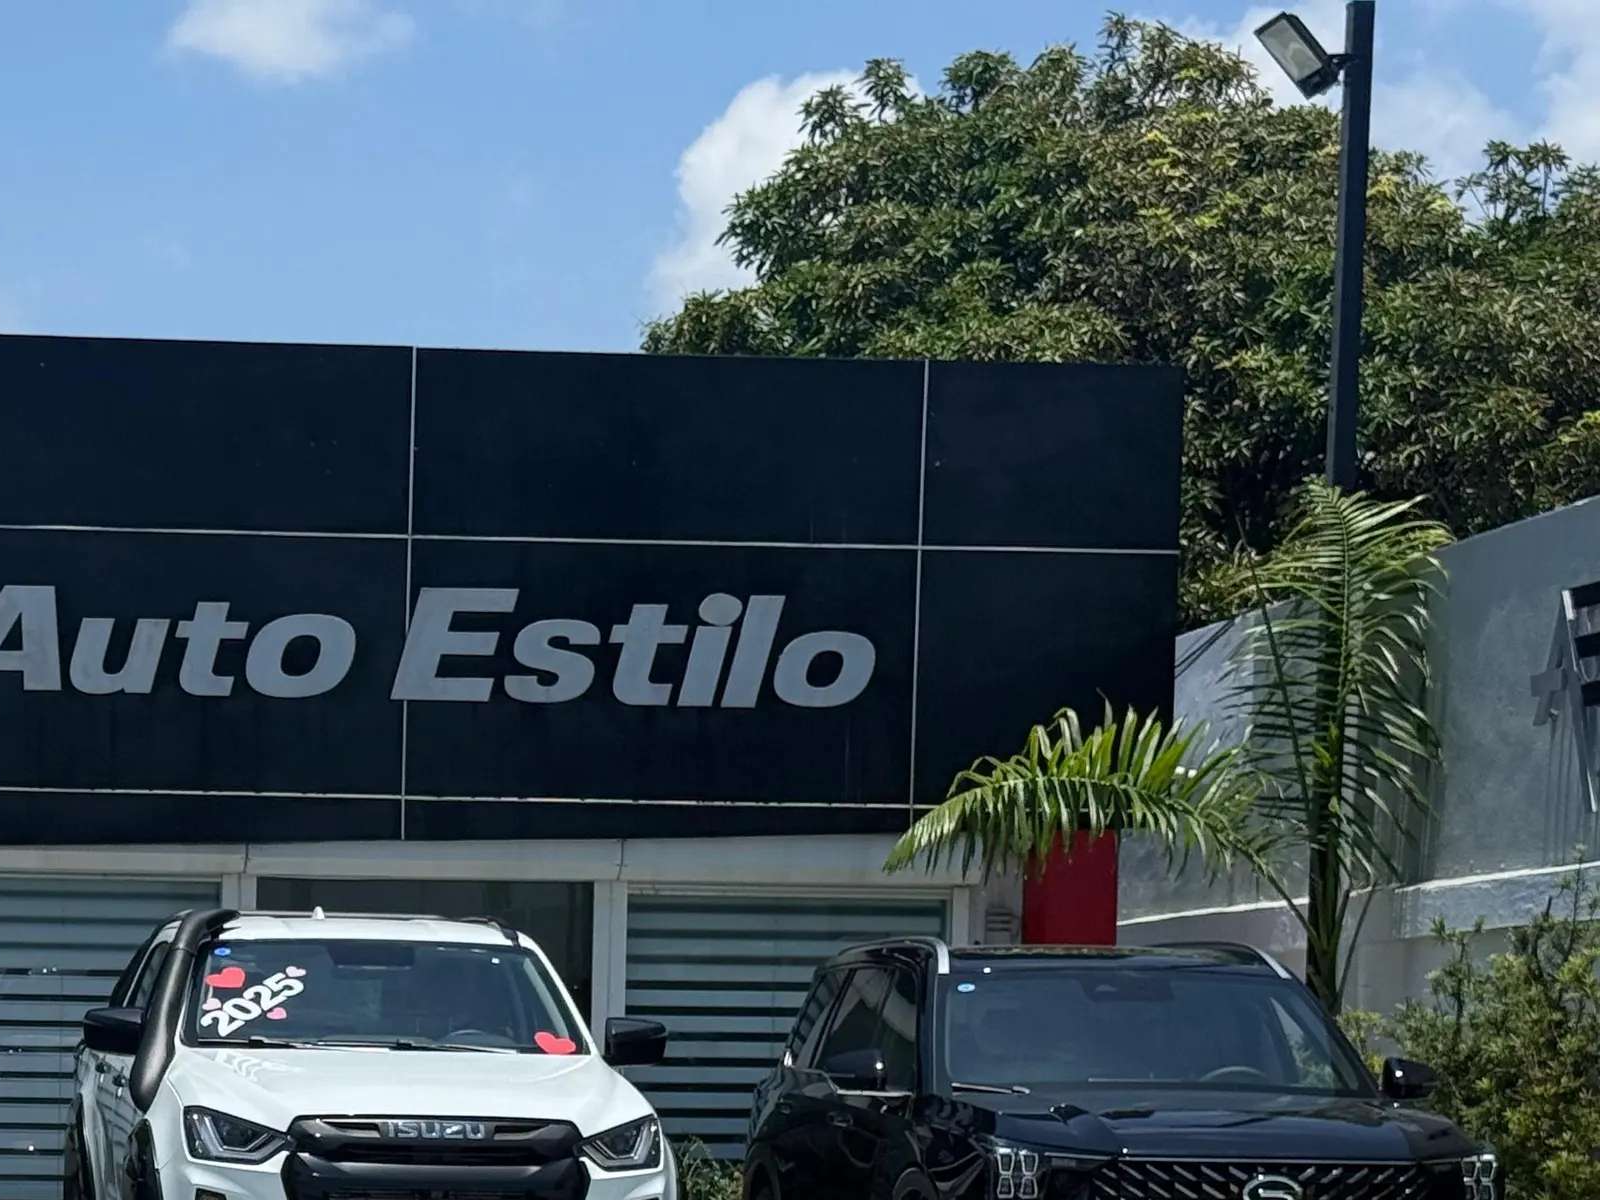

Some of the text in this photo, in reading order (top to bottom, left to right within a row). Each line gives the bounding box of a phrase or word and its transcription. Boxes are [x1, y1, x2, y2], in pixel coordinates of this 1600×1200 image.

[389, 586, 877, 709] Estilo
[200, 972, 305, 1037] 2025
[387, 1120, 486, 1140] ISUZU
